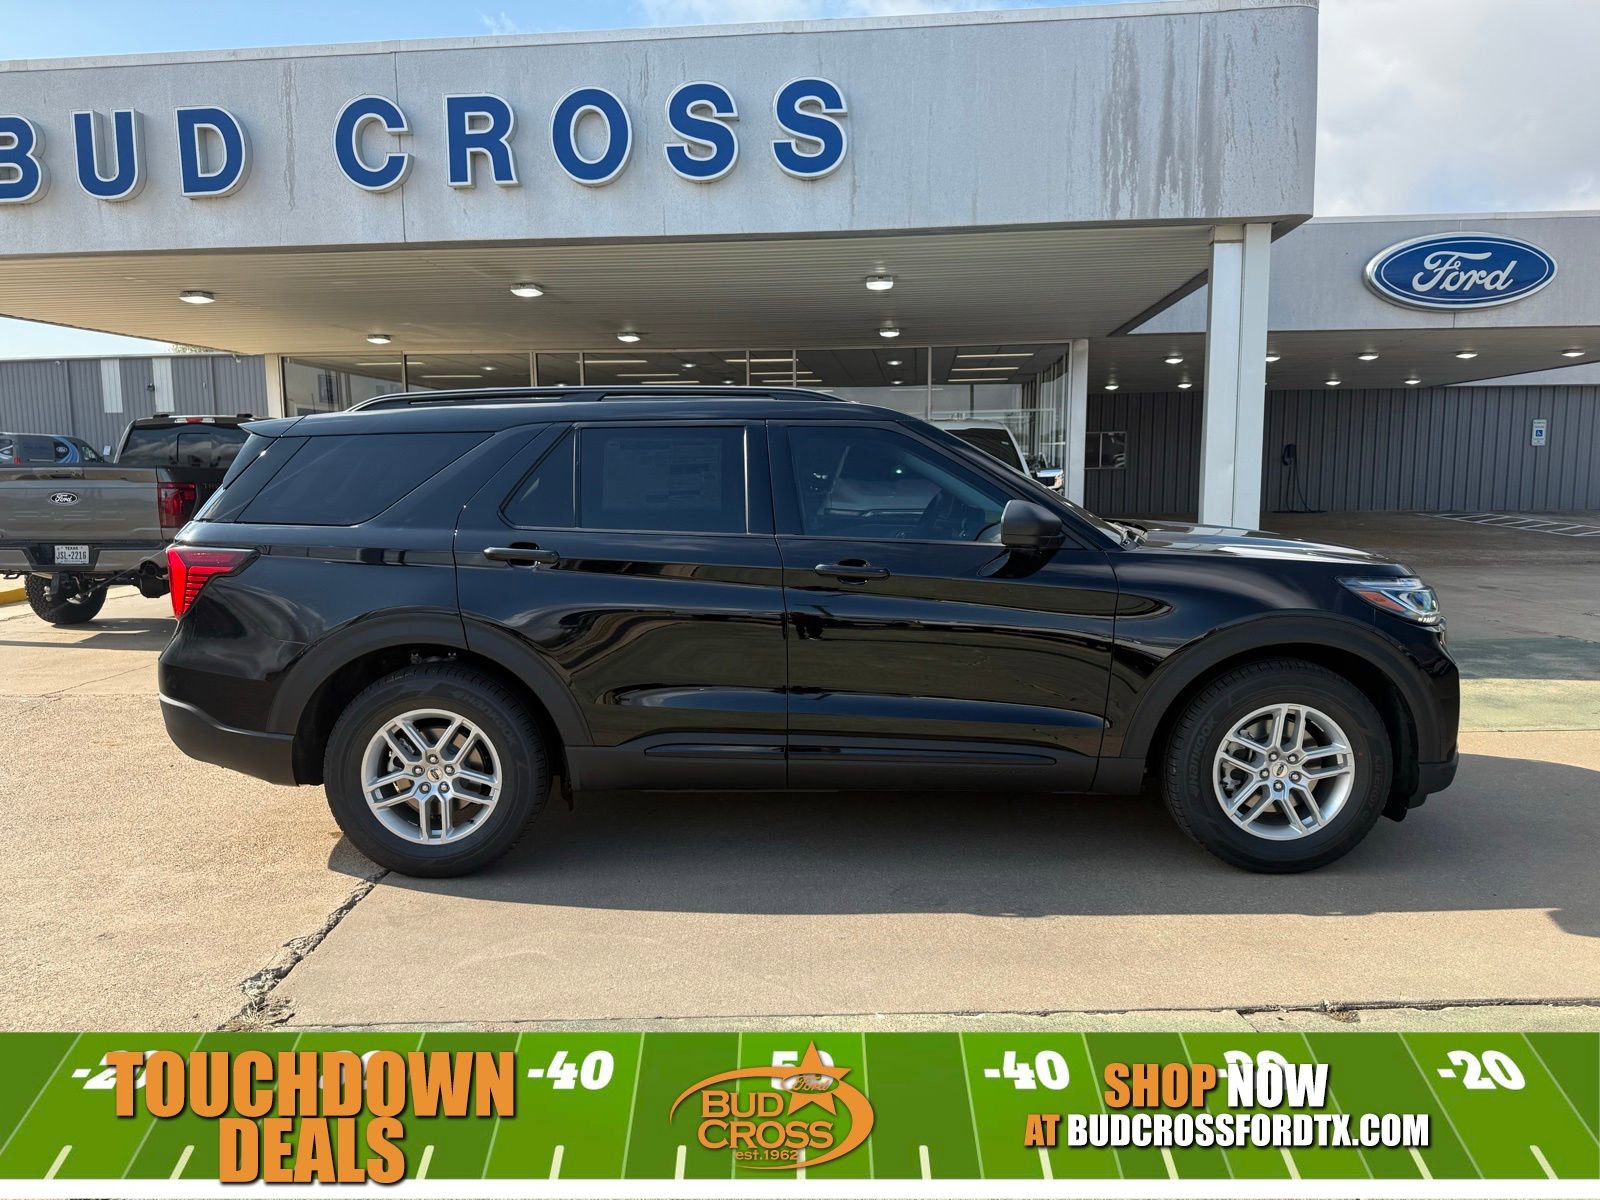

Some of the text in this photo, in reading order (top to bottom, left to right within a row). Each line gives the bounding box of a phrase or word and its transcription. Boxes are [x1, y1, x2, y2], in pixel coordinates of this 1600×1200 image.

[0, 77, 848, 203] BUD CROSS
[1412, 251, 1518, 292] Ford
